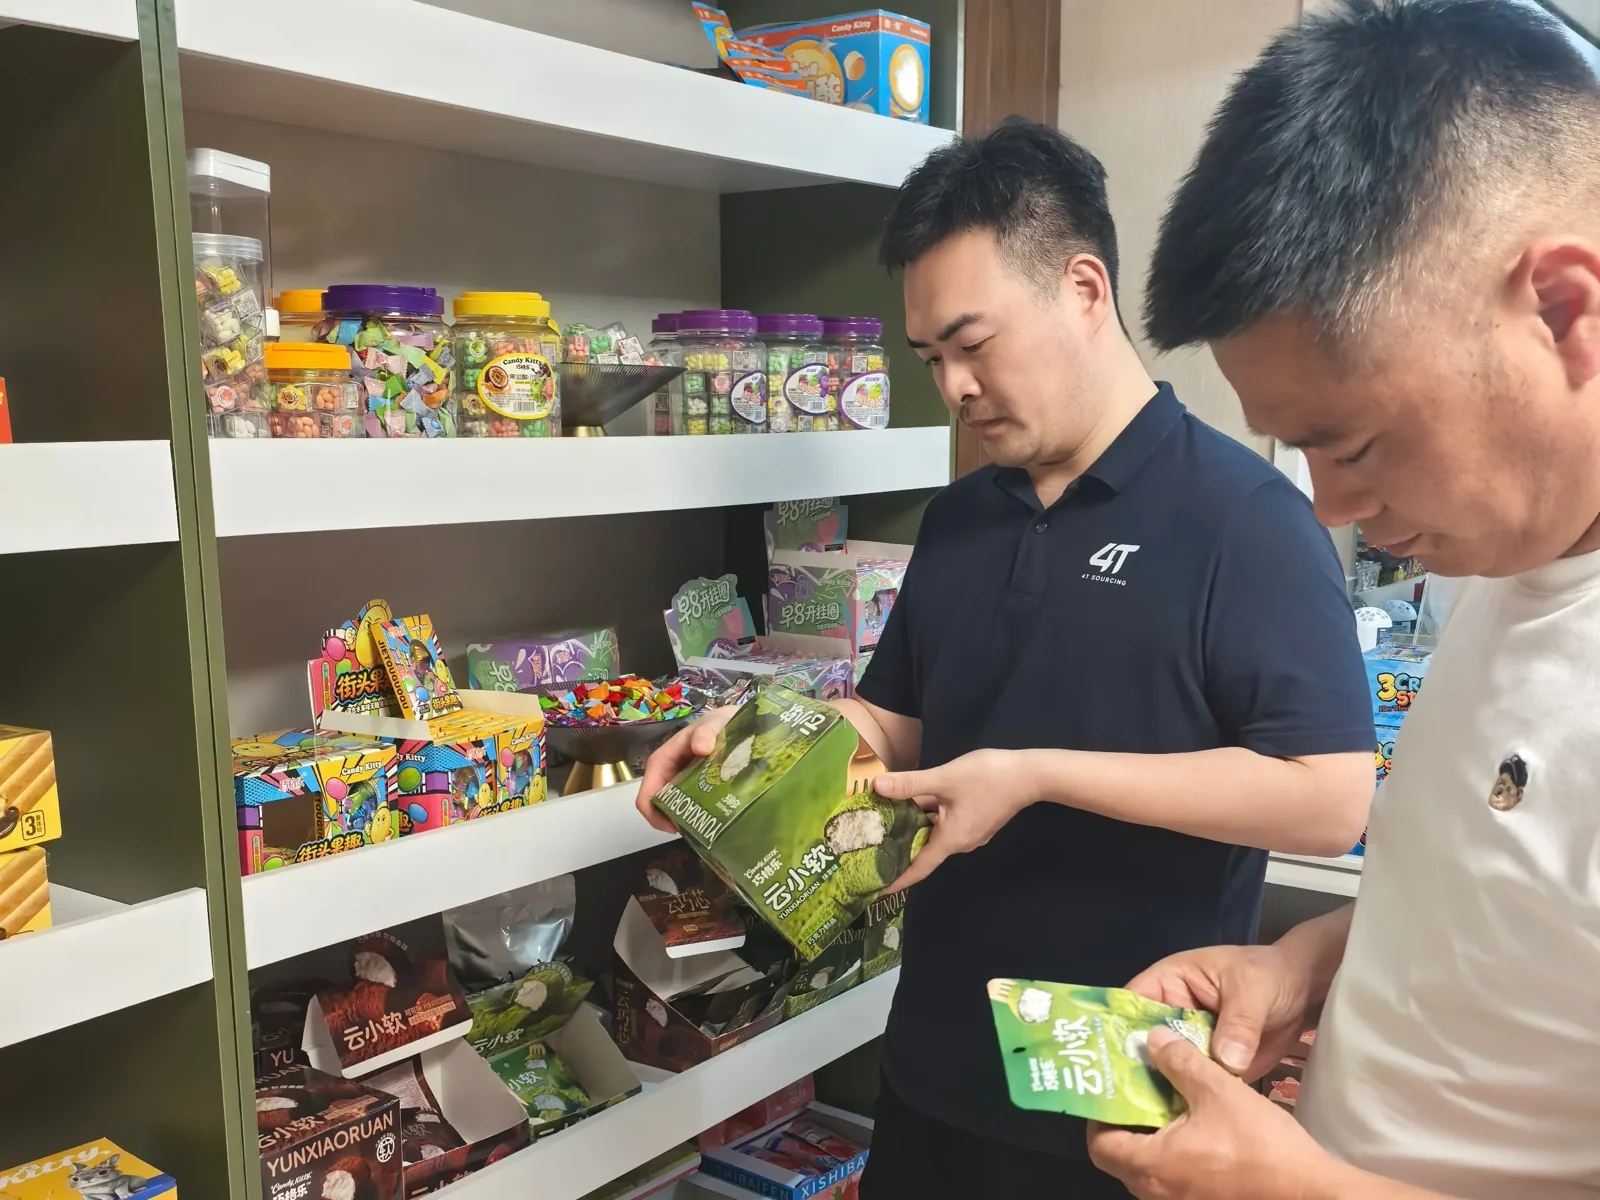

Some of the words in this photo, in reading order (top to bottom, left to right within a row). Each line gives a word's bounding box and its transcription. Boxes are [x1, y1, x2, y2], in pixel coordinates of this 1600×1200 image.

[502, 358, 525, 366] Candy
[525, 357, 542, 366] Kitty
[1089, 542, 1141, 574] 4T
[1091, 575, 1127, 586] SOURCING
[677, 580, 731, 626] 早8开挂圈
[779, 602, 839, 629] 早8开挂圈
[336, 671, 390, 701] 街头果
[377, 640, 410, 710] JIETOUGUOQU
[341, 765, 364, 776] Candy
[364, 761, 382, 771] Kitty
[405, 753, 426, 763] Kitty
[24, 815, 37, 837] 3
[655, 782, 723, 843] YUNXIAORUAN
[297, 833, 364, 864] 街头果趣
[763, 844, 835, 911] 云小软
[778, 881, 821, 921] YUNXIAORUAN
[343, 1011, 407, 1051] 云小软
[472, 1027, 525, 1053] 云小软
[266, 1110, 394, 1178] YUNXIAORUAN
